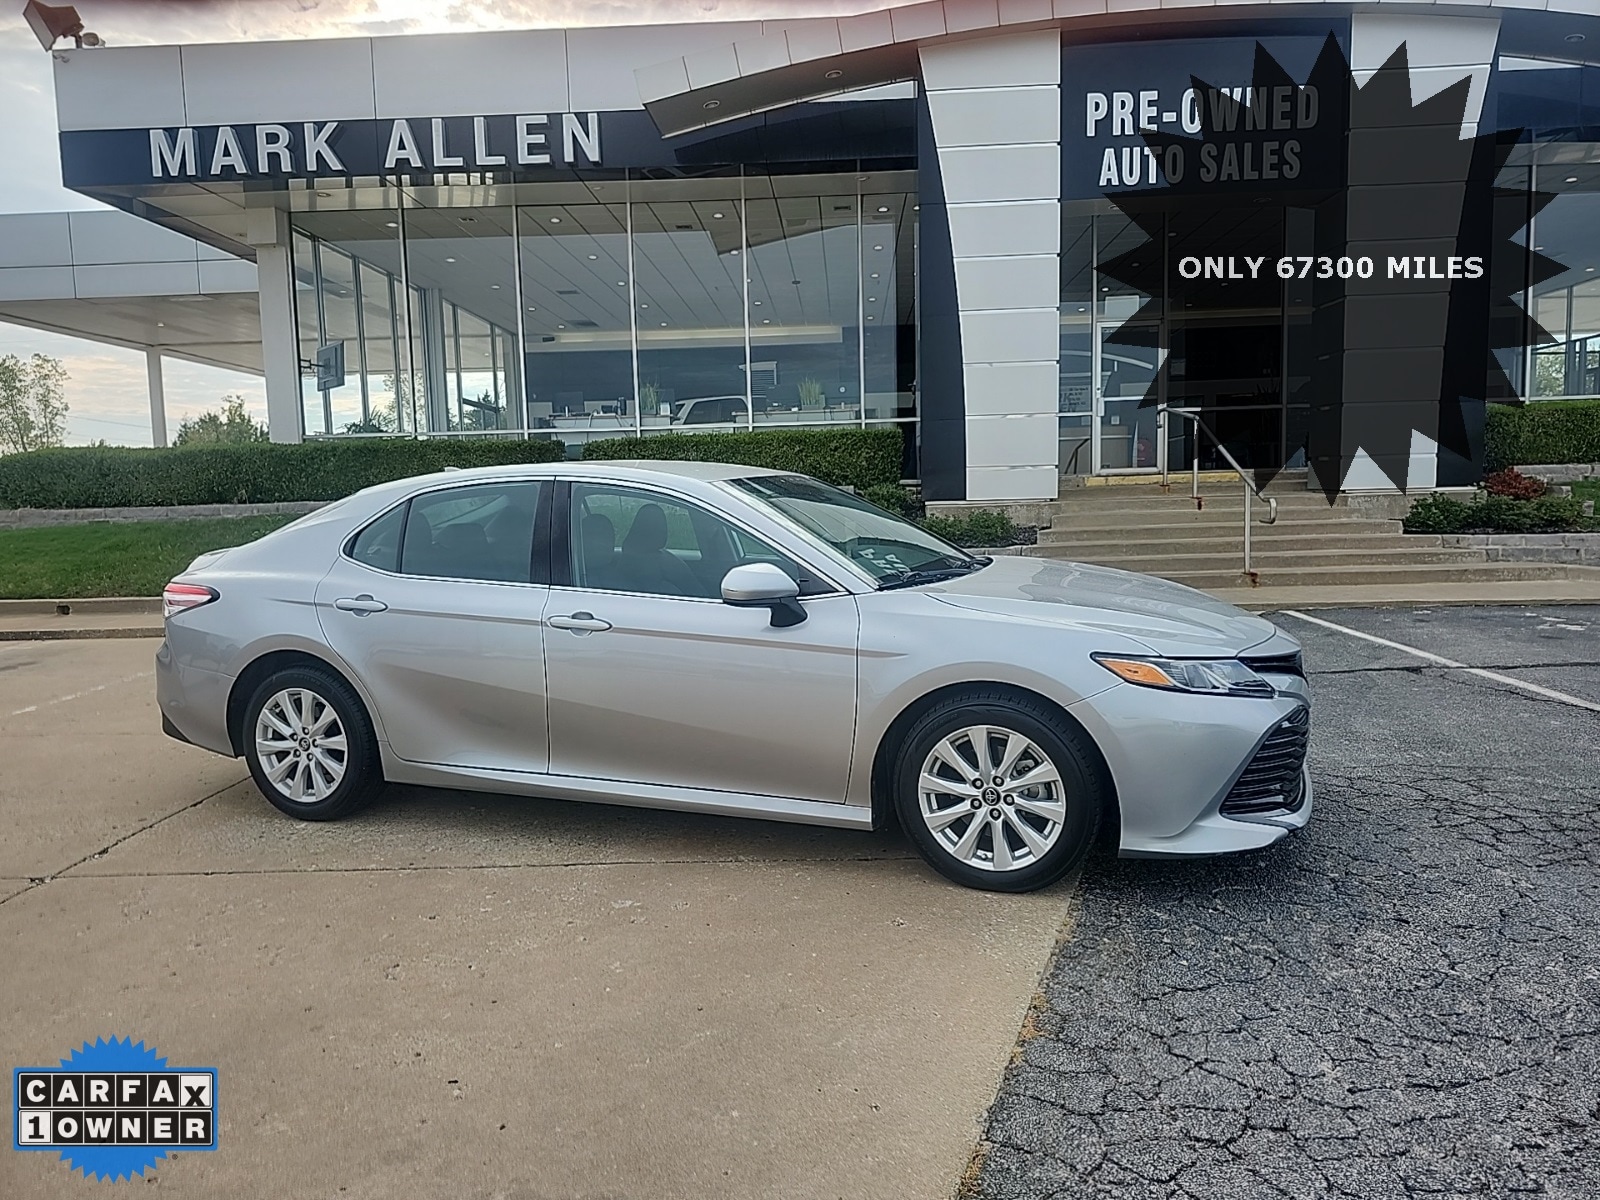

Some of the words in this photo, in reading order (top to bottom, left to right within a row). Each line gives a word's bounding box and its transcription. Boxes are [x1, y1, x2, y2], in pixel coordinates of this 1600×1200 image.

[1085, 85, 1319, 137] PRE-OWNED
[148, 121, 346, 177] MARK
[384, 112, 601, 169] ALLEN
[1098, 144, 1185, 186] AUTO
[1200, 139, 1301, 183] SALES
